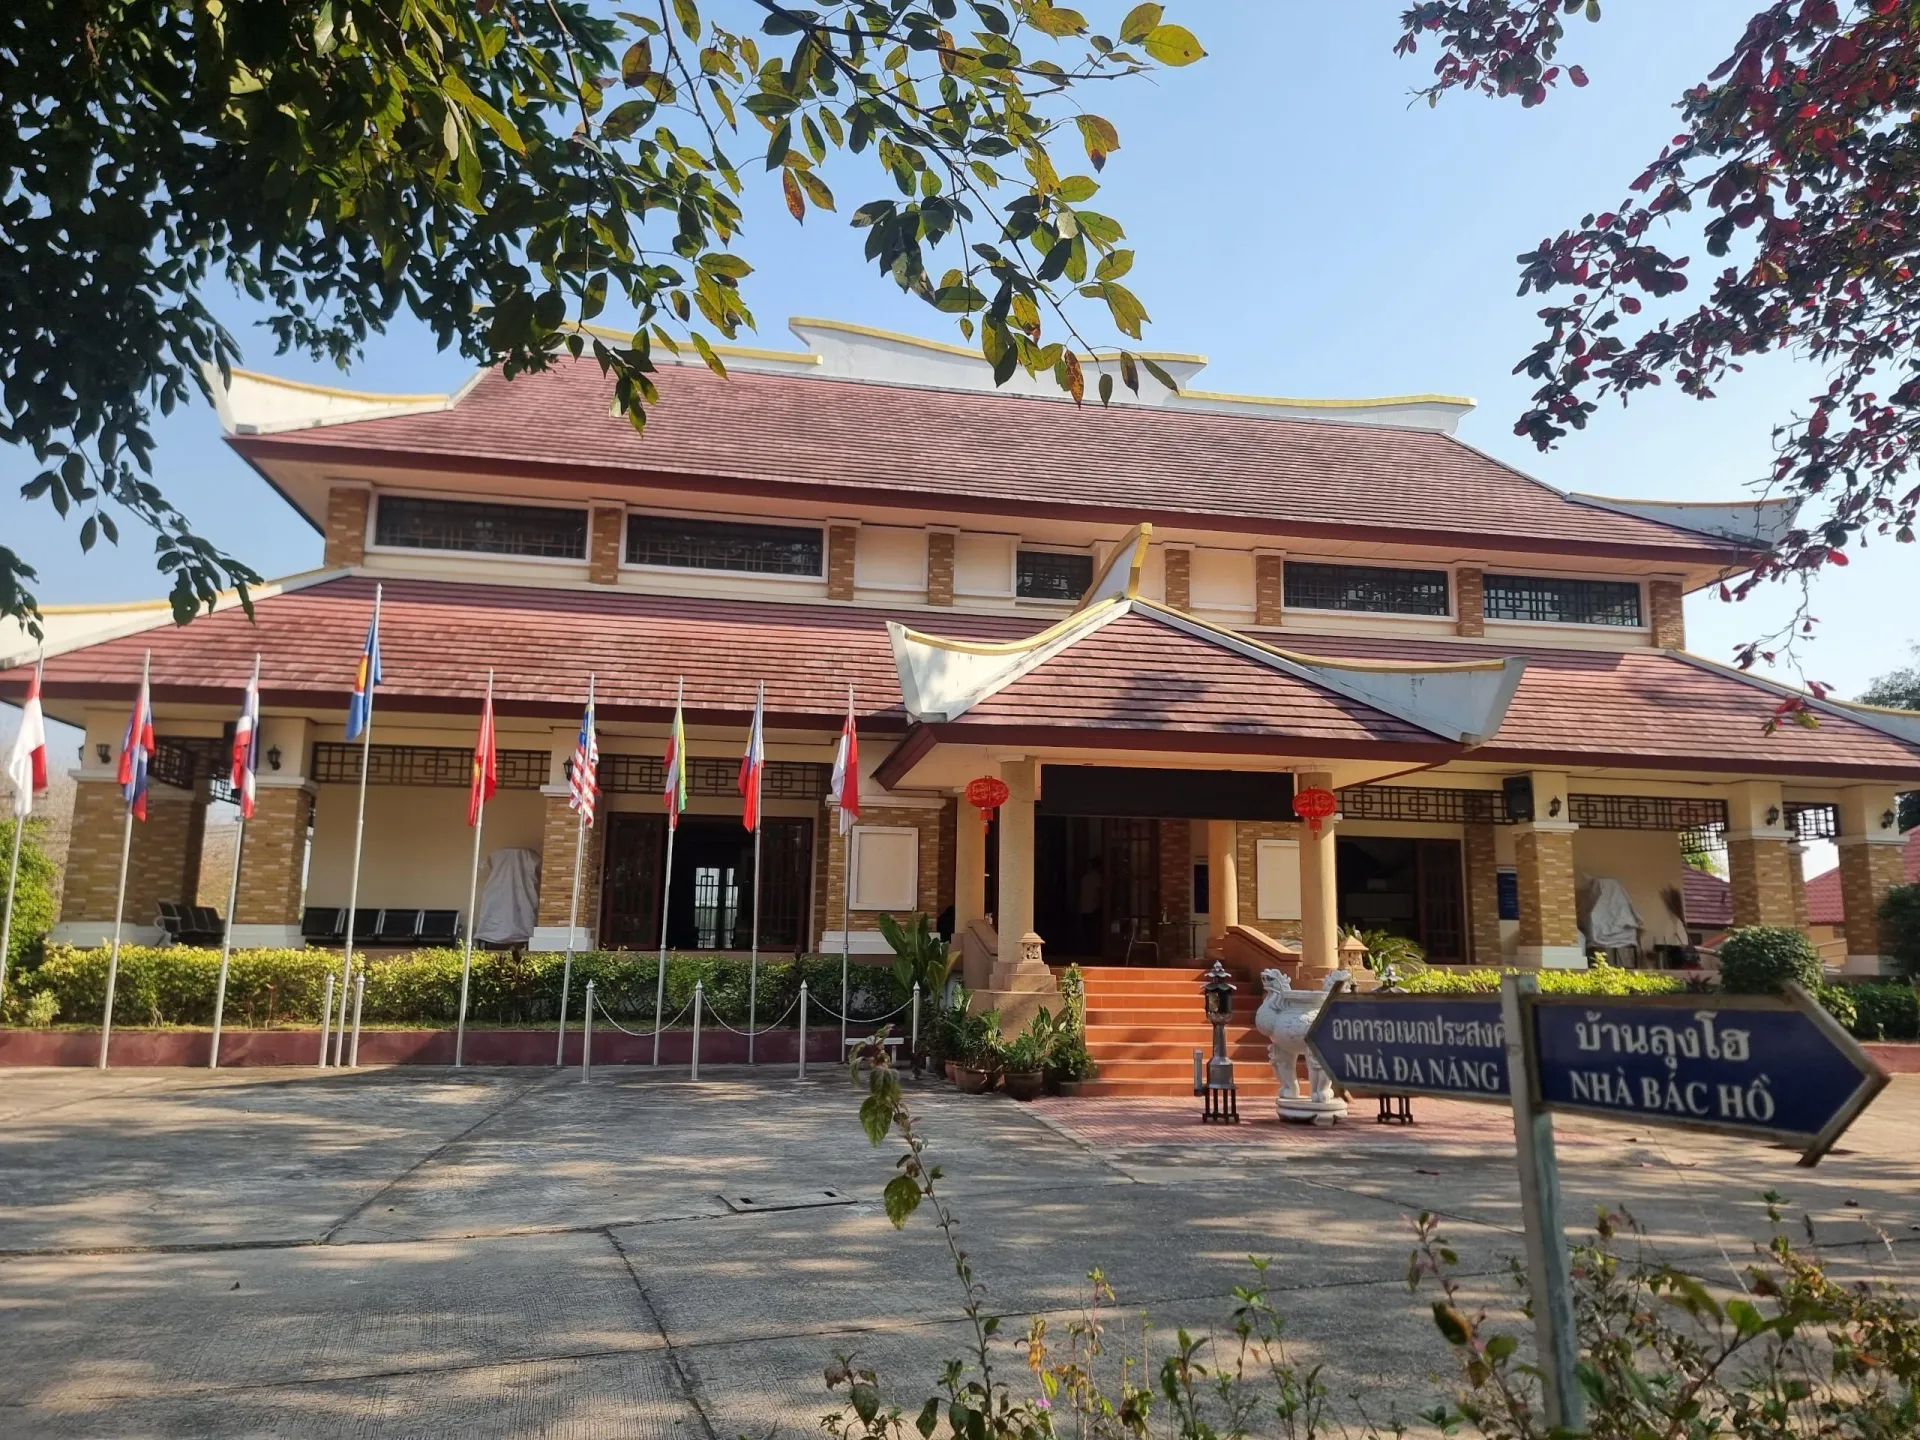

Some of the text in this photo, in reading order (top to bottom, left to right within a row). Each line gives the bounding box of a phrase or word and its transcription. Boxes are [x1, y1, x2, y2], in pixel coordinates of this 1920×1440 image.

[1332, 1013, 1505, 1049] อาคารอเนกประสงค
[1575, 1010, 1751, 1070] บ้านลุงโฮ
[1344, 1049, 1500, 1091] NHÀ ĐA NĂNG
[1568, 1066, 1775, 1121] NHÀ BÁC HỒ
